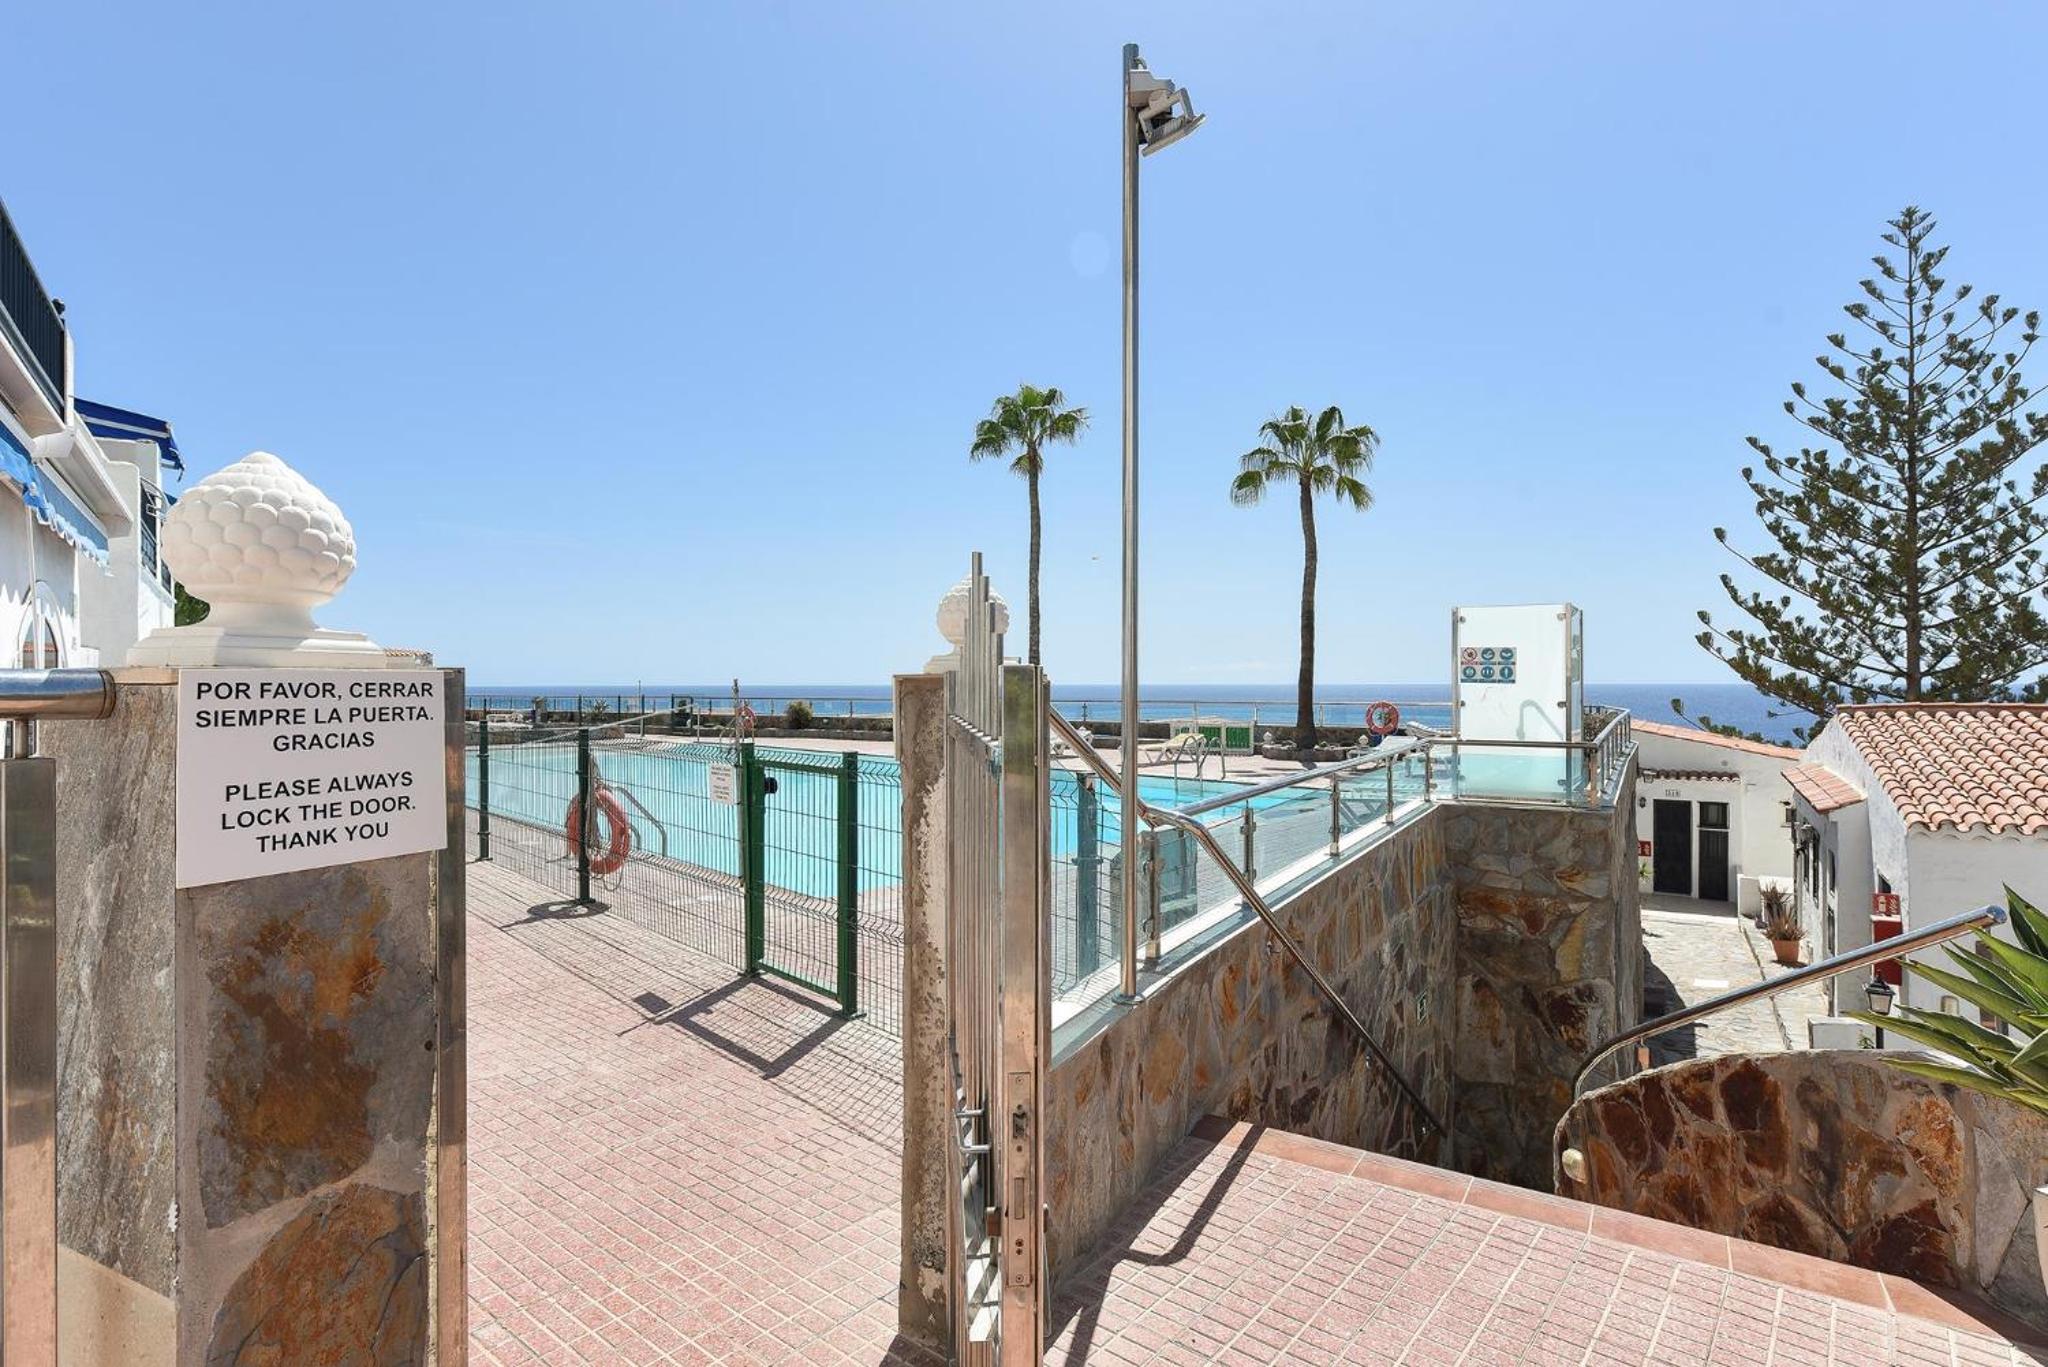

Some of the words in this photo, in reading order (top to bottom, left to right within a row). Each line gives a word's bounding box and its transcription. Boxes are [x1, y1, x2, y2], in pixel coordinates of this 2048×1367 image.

[197, 683, 251, 700] POR
[260, 683, 342, 700] FAVOR,
[349, 683, 433, 698] CERRAR
[196, 709, 306, 728] SIEMPRE
[315, 708, 342, 724] LA
[349, 706, 433, 723] PUERTA.
[273, 732, 374, 751] GRACIAS
[226, 778, 320, 802] PLEASE
[328, 771, 413, 793] ALWAYS
[222, 807, 290, 830] LOCK
[298, 802, 342, 821] THE
[351, 796, 415, 816] DOOR.
[256, 828, 337, 852] THANK
[345, 822, 388, 841] YOU
